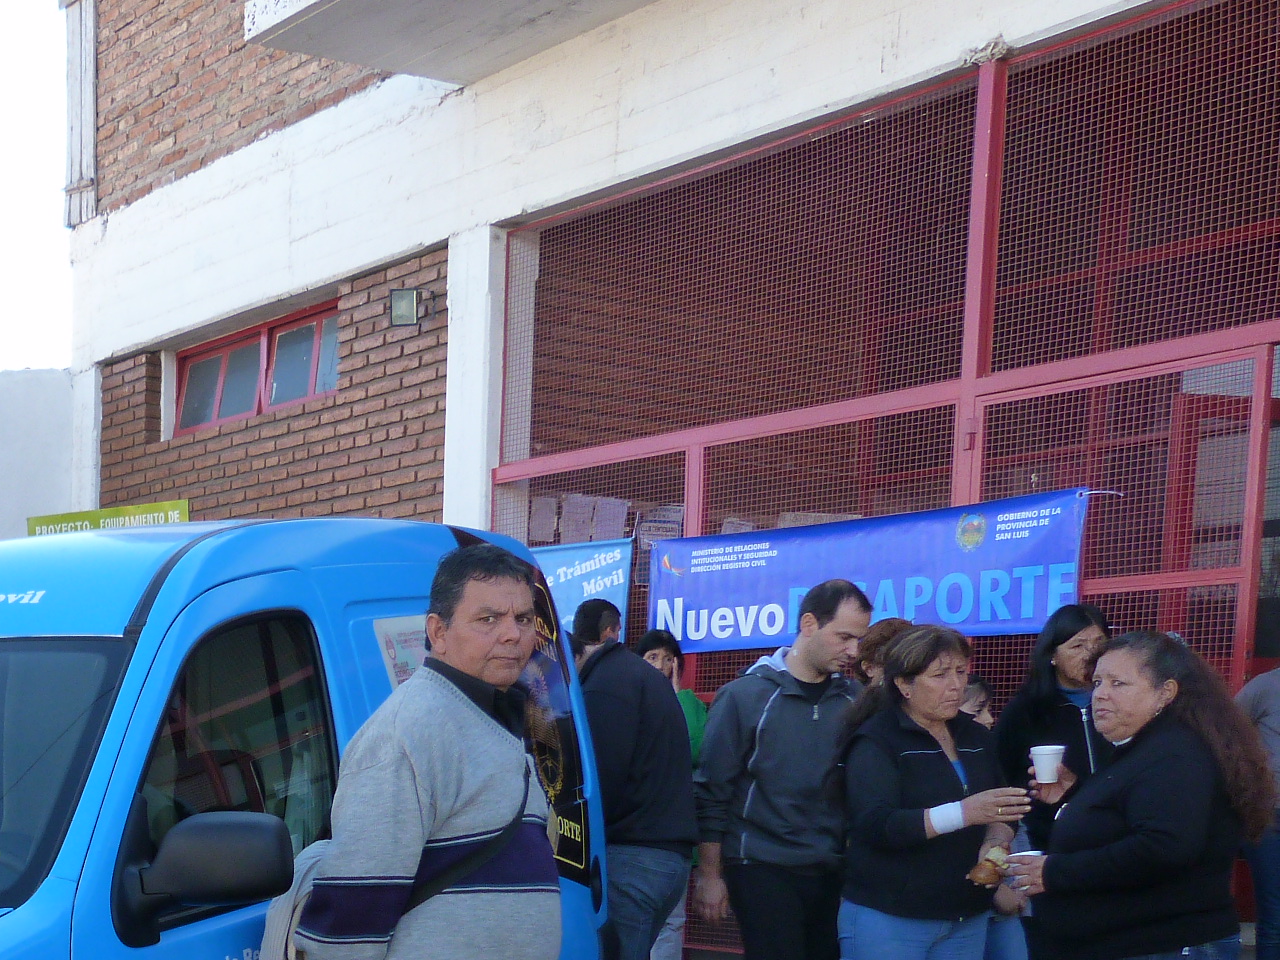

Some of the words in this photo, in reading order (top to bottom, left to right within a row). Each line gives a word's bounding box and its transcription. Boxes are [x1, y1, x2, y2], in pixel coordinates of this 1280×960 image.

[168, 510, 180, 523] DE
[997, 510, 1038, 522] GOBIERNO
[1039, 508, 1051, 516] DE
[1051, 507, 1061, 515] LA
[996, 519, 1038, 531] PROVINCIA
[1039, 518, 1050, 526] DE
[995, 532, 1011, 541] SAN
[1013, 530, 1029, 539] LUIS
[691, 547, 724, 557] MINISTERIO
[734, 542, 770, 552] RELACIONES
[743, 550, 778, 560] SEGURIDAD
[556, 549, 622, 583] Trámites
[690, 562, 722, 573] DIRECCIÓN
[722, 561, 751, 570] REGISTRO
[751, 559, 767, 567] CIVIL
[582, 569, 624, 597] Móvil
[656, 597, 784, 642] Nuevo
